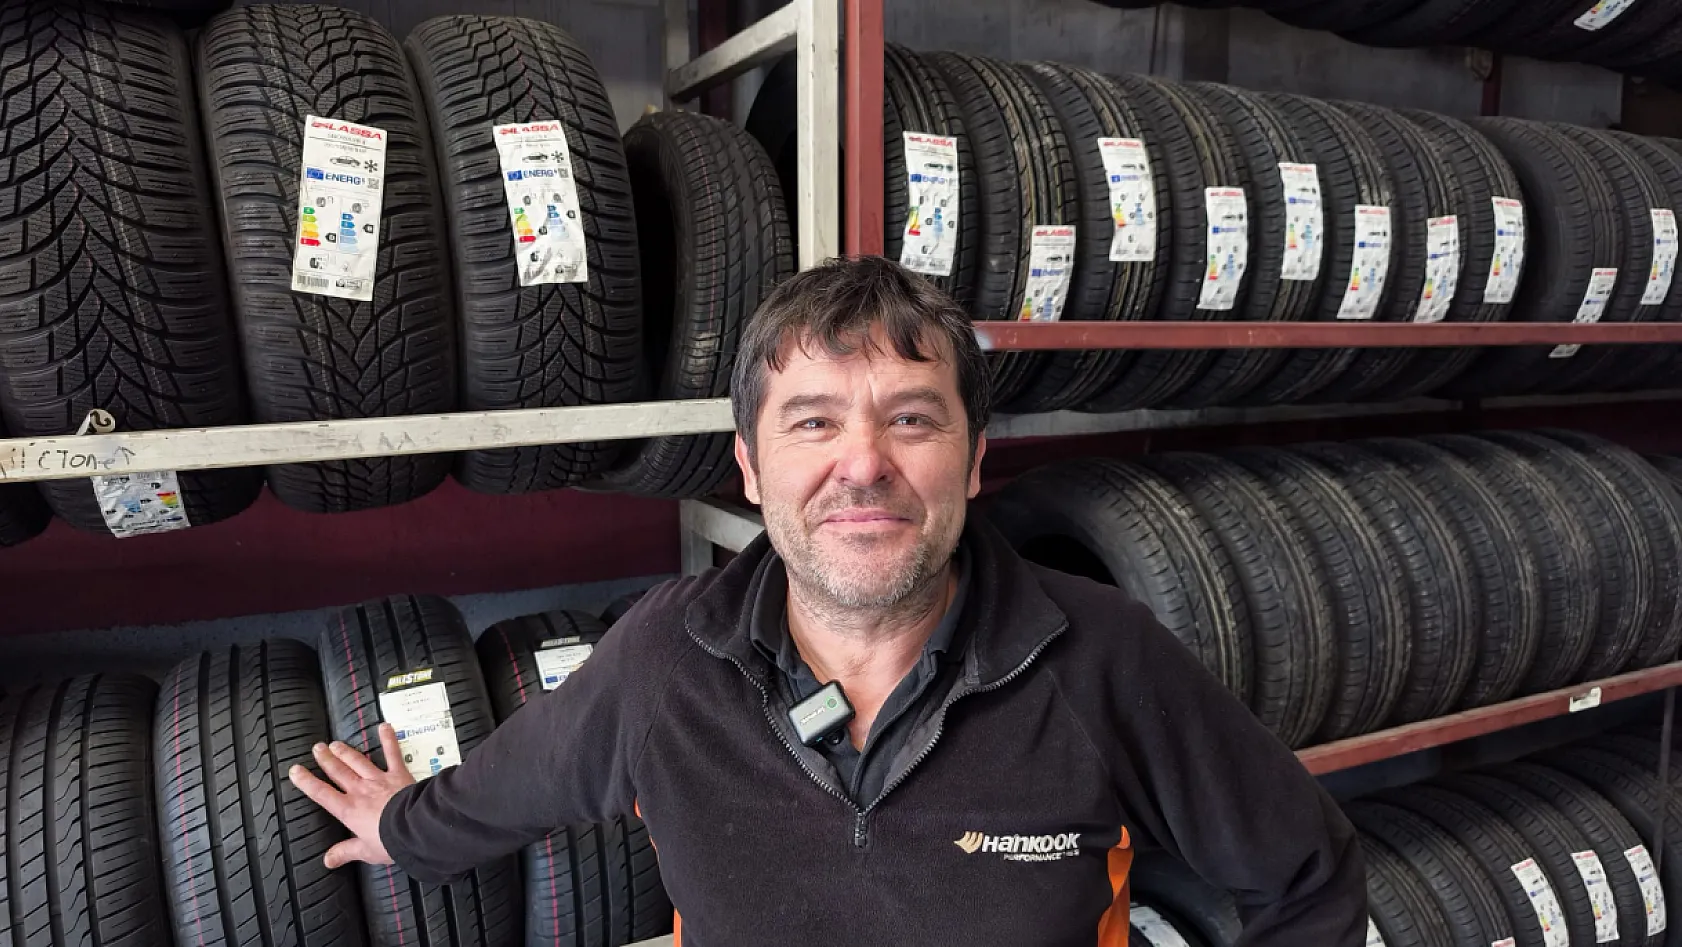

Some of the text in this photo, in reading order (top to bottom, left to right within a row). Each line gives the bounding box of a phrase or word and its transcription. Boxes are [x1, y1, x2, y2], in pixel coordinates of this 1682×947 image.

[328, 123, 382, 141] LASSA
[512, 124, 560, 135] LASSA
[325, 172, 361, 185] ENERG
[523, 169, 554, 178] ENERG
